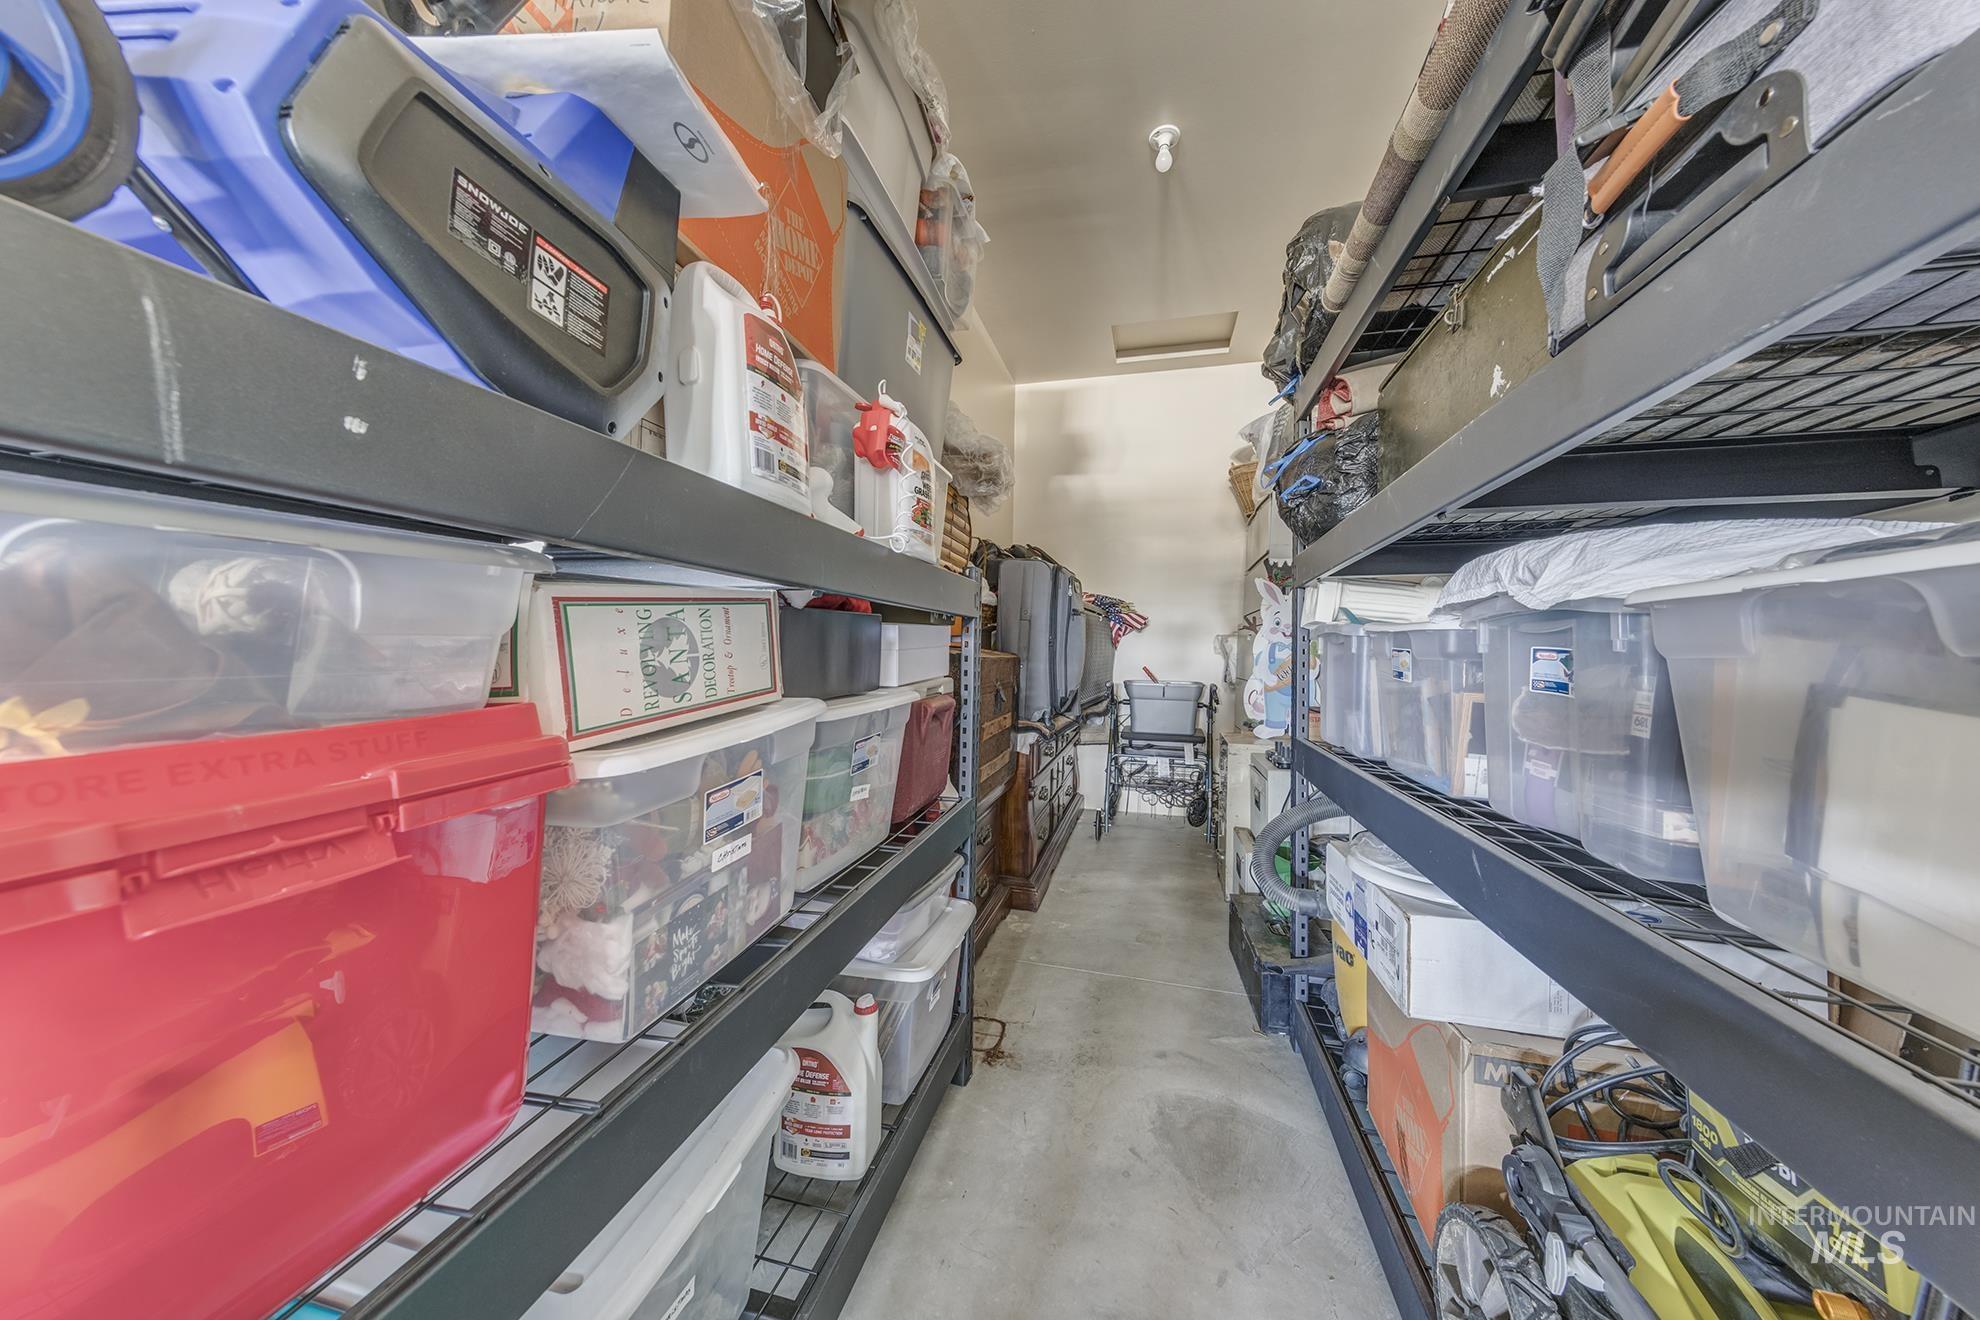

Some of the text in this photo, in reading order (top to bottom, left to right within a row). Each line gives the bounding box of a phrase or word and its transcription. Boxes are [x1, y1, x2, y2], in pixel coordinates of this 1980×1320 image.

[636, 607, 660, 712] REVOLVING
[665, 607, 693, 704] SANTA
[698, 608, 718, 699] DECORATION
[722, 607, 738, 694] Treetop & Ornament
[168, 746, 318, 787] EXTRA
[328, 728, 430, 763] STUFF
[805, 1070, 830, 1080] DEFENSE
[1692, 1115, 1718, 1145] 1800
[1699, 1133, 1712, 1151] PSI
